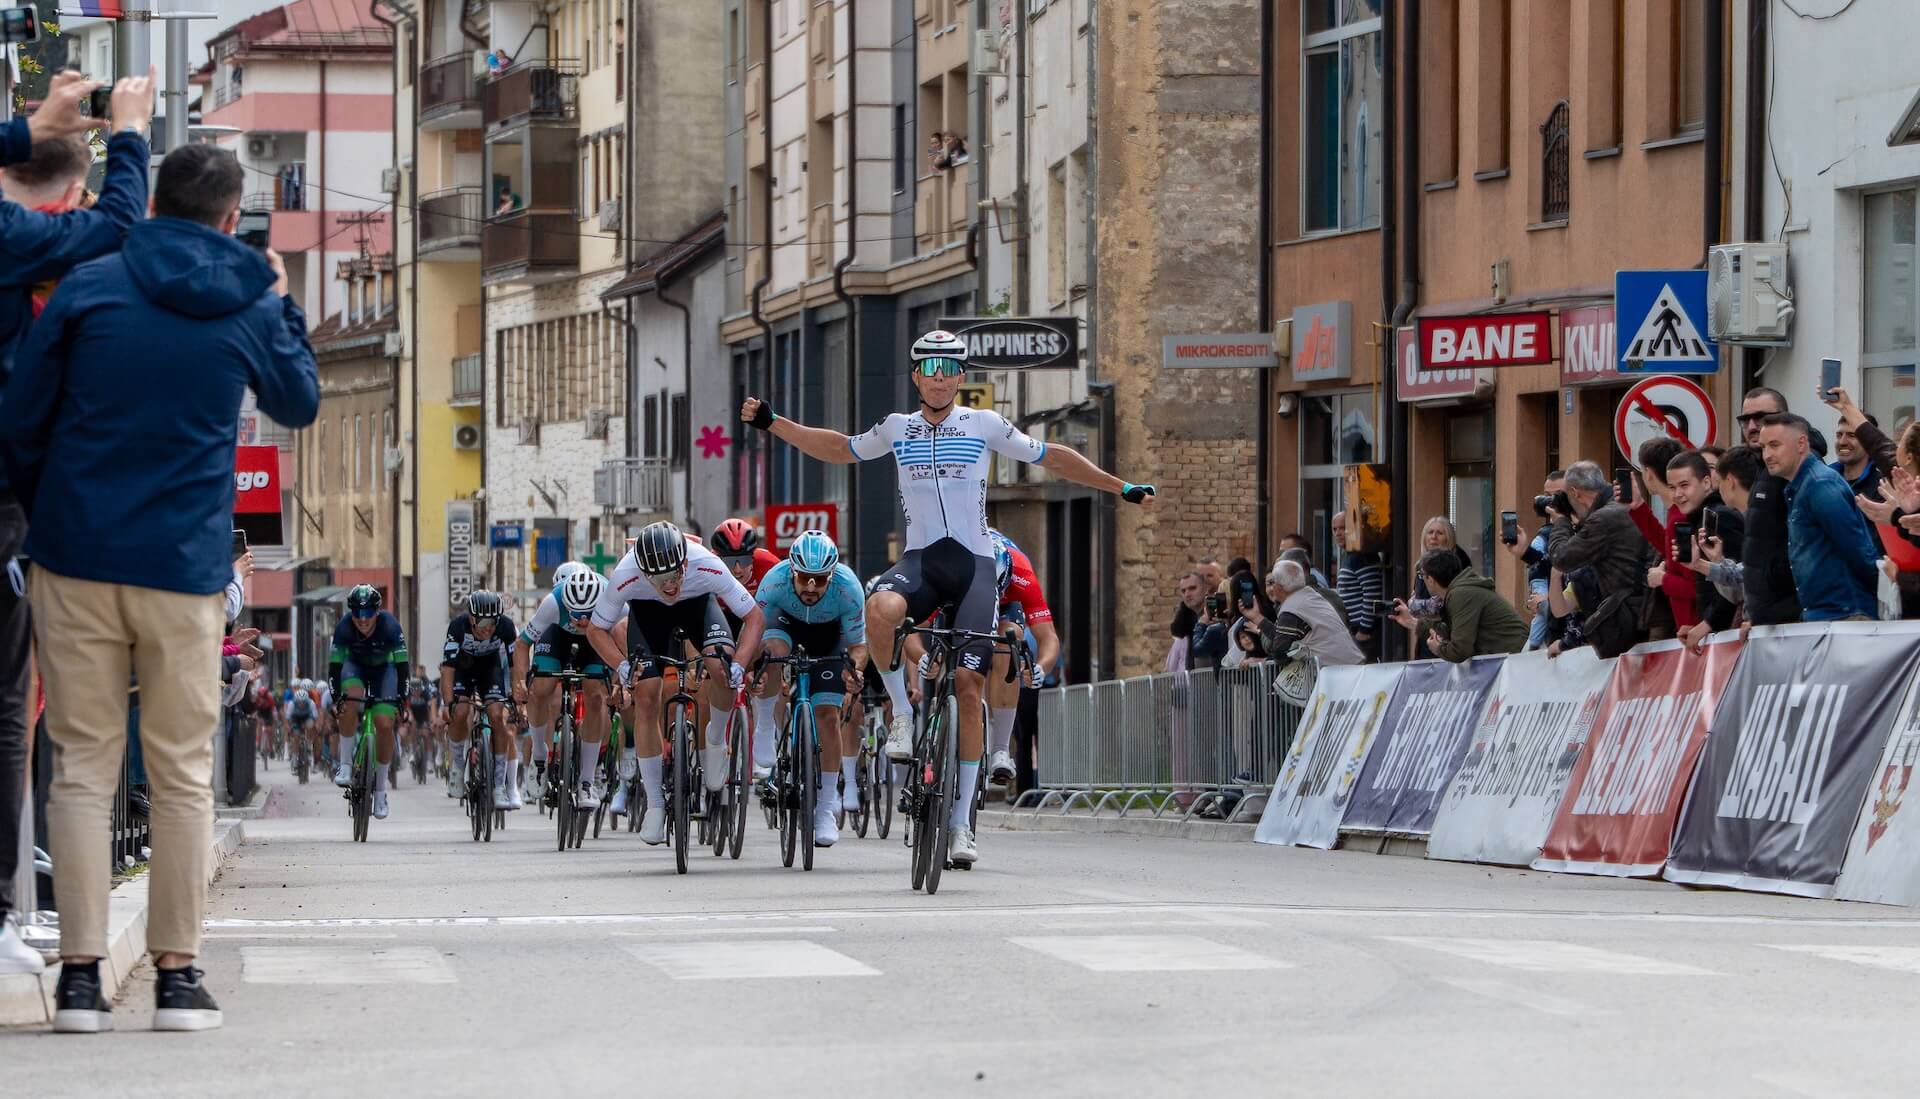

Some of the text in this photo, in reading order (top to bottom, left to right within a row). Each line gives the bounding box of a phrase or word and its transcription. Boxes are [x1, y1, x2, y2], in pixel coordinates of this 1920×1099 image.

[1175, 343, 1268, 359] MIKROKREDITI
[1431, 324, 1536, 364] BANE
[1564, 323, 1616, 373] KNJI
[775, 510, 830, 537] cm
[449, 521, 471, 606] BROTHERS
[1372, 690, 1480, 811] БРАТУНАЦ
[1716, 684, 1849, 851] ШАБАЦ
